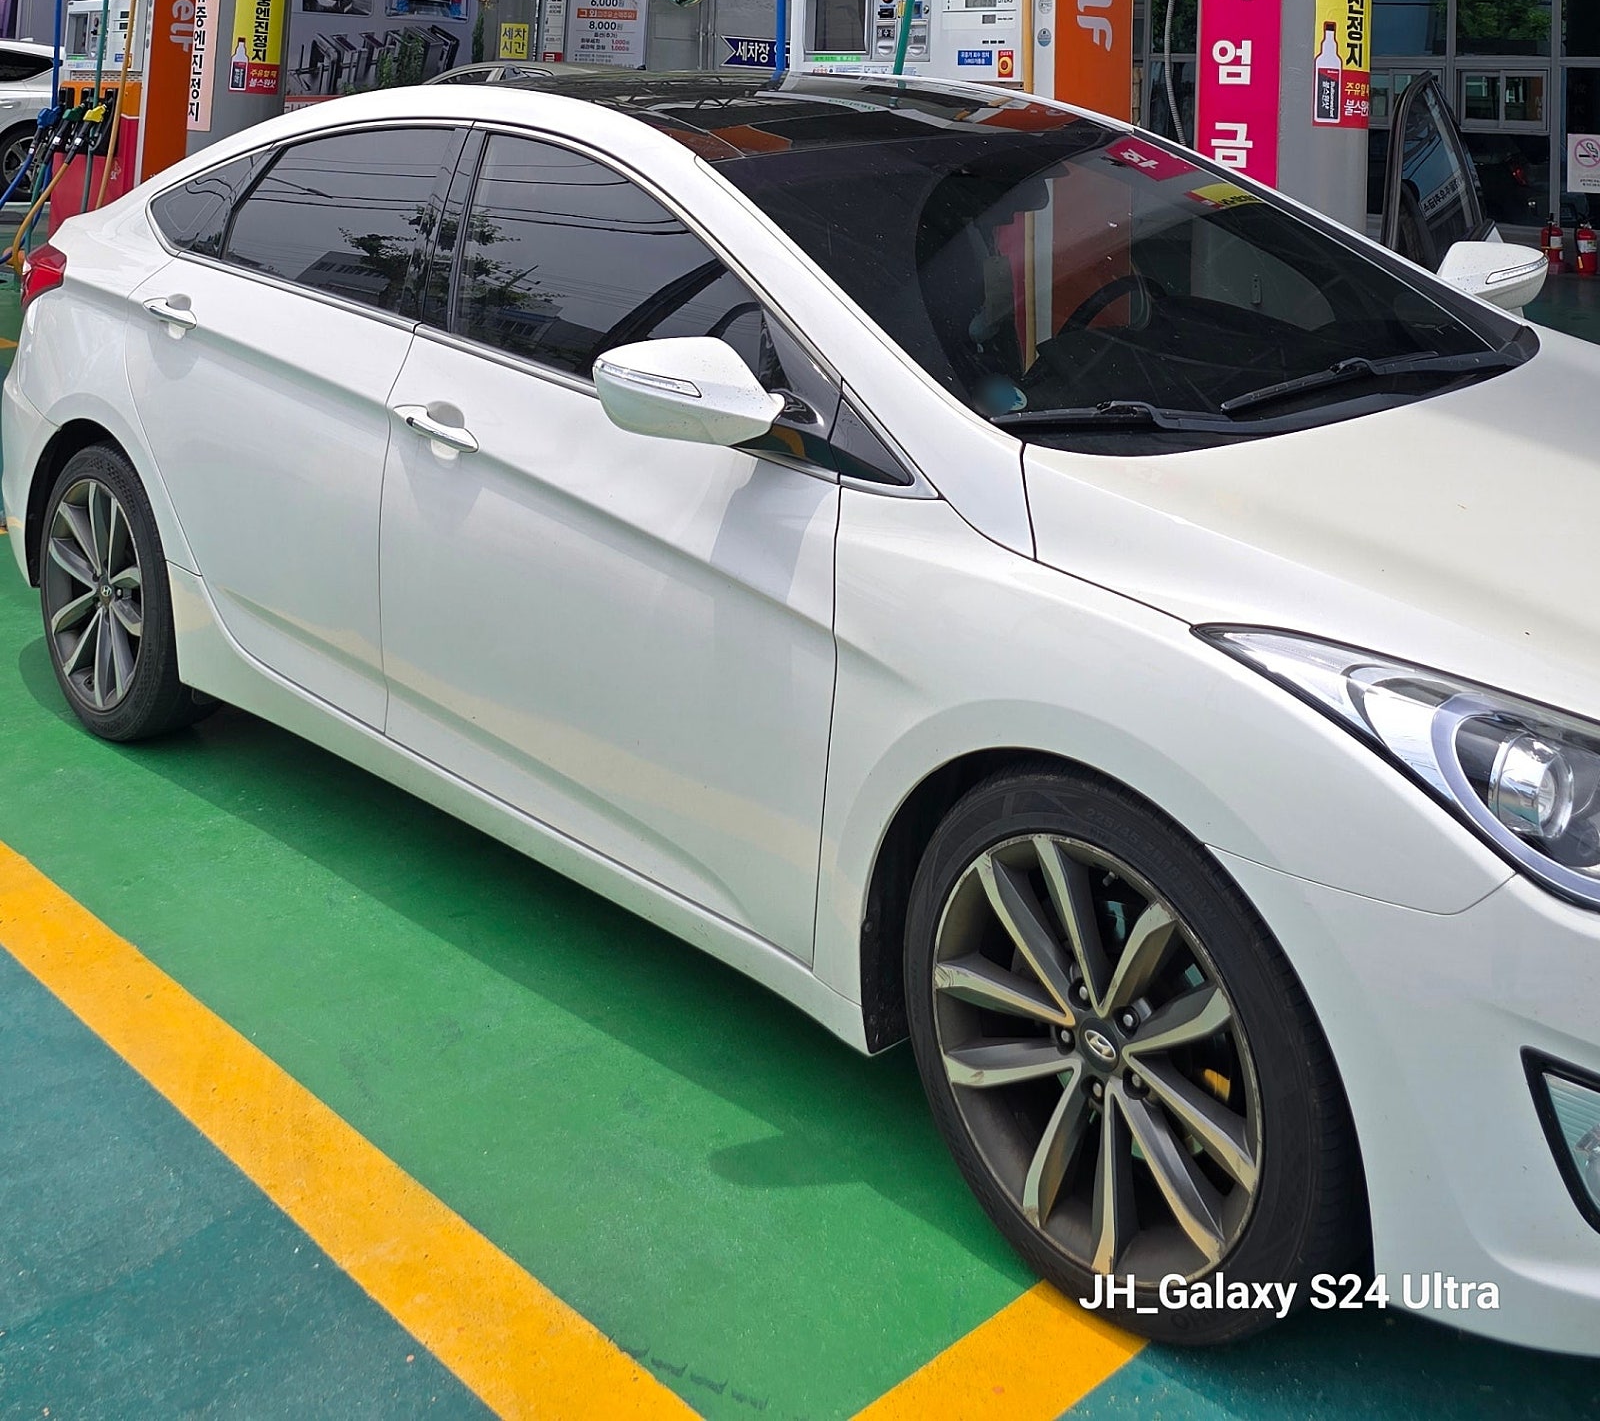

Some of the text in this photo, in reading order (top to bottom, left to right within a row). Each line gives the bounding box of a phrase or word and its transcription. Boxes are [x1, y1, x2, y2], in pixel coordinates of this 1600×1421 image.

[502, 27, 527, 41] 세차
[501, 41, 526, 55] 시간
[736, 41, 770, 63] 세차장
